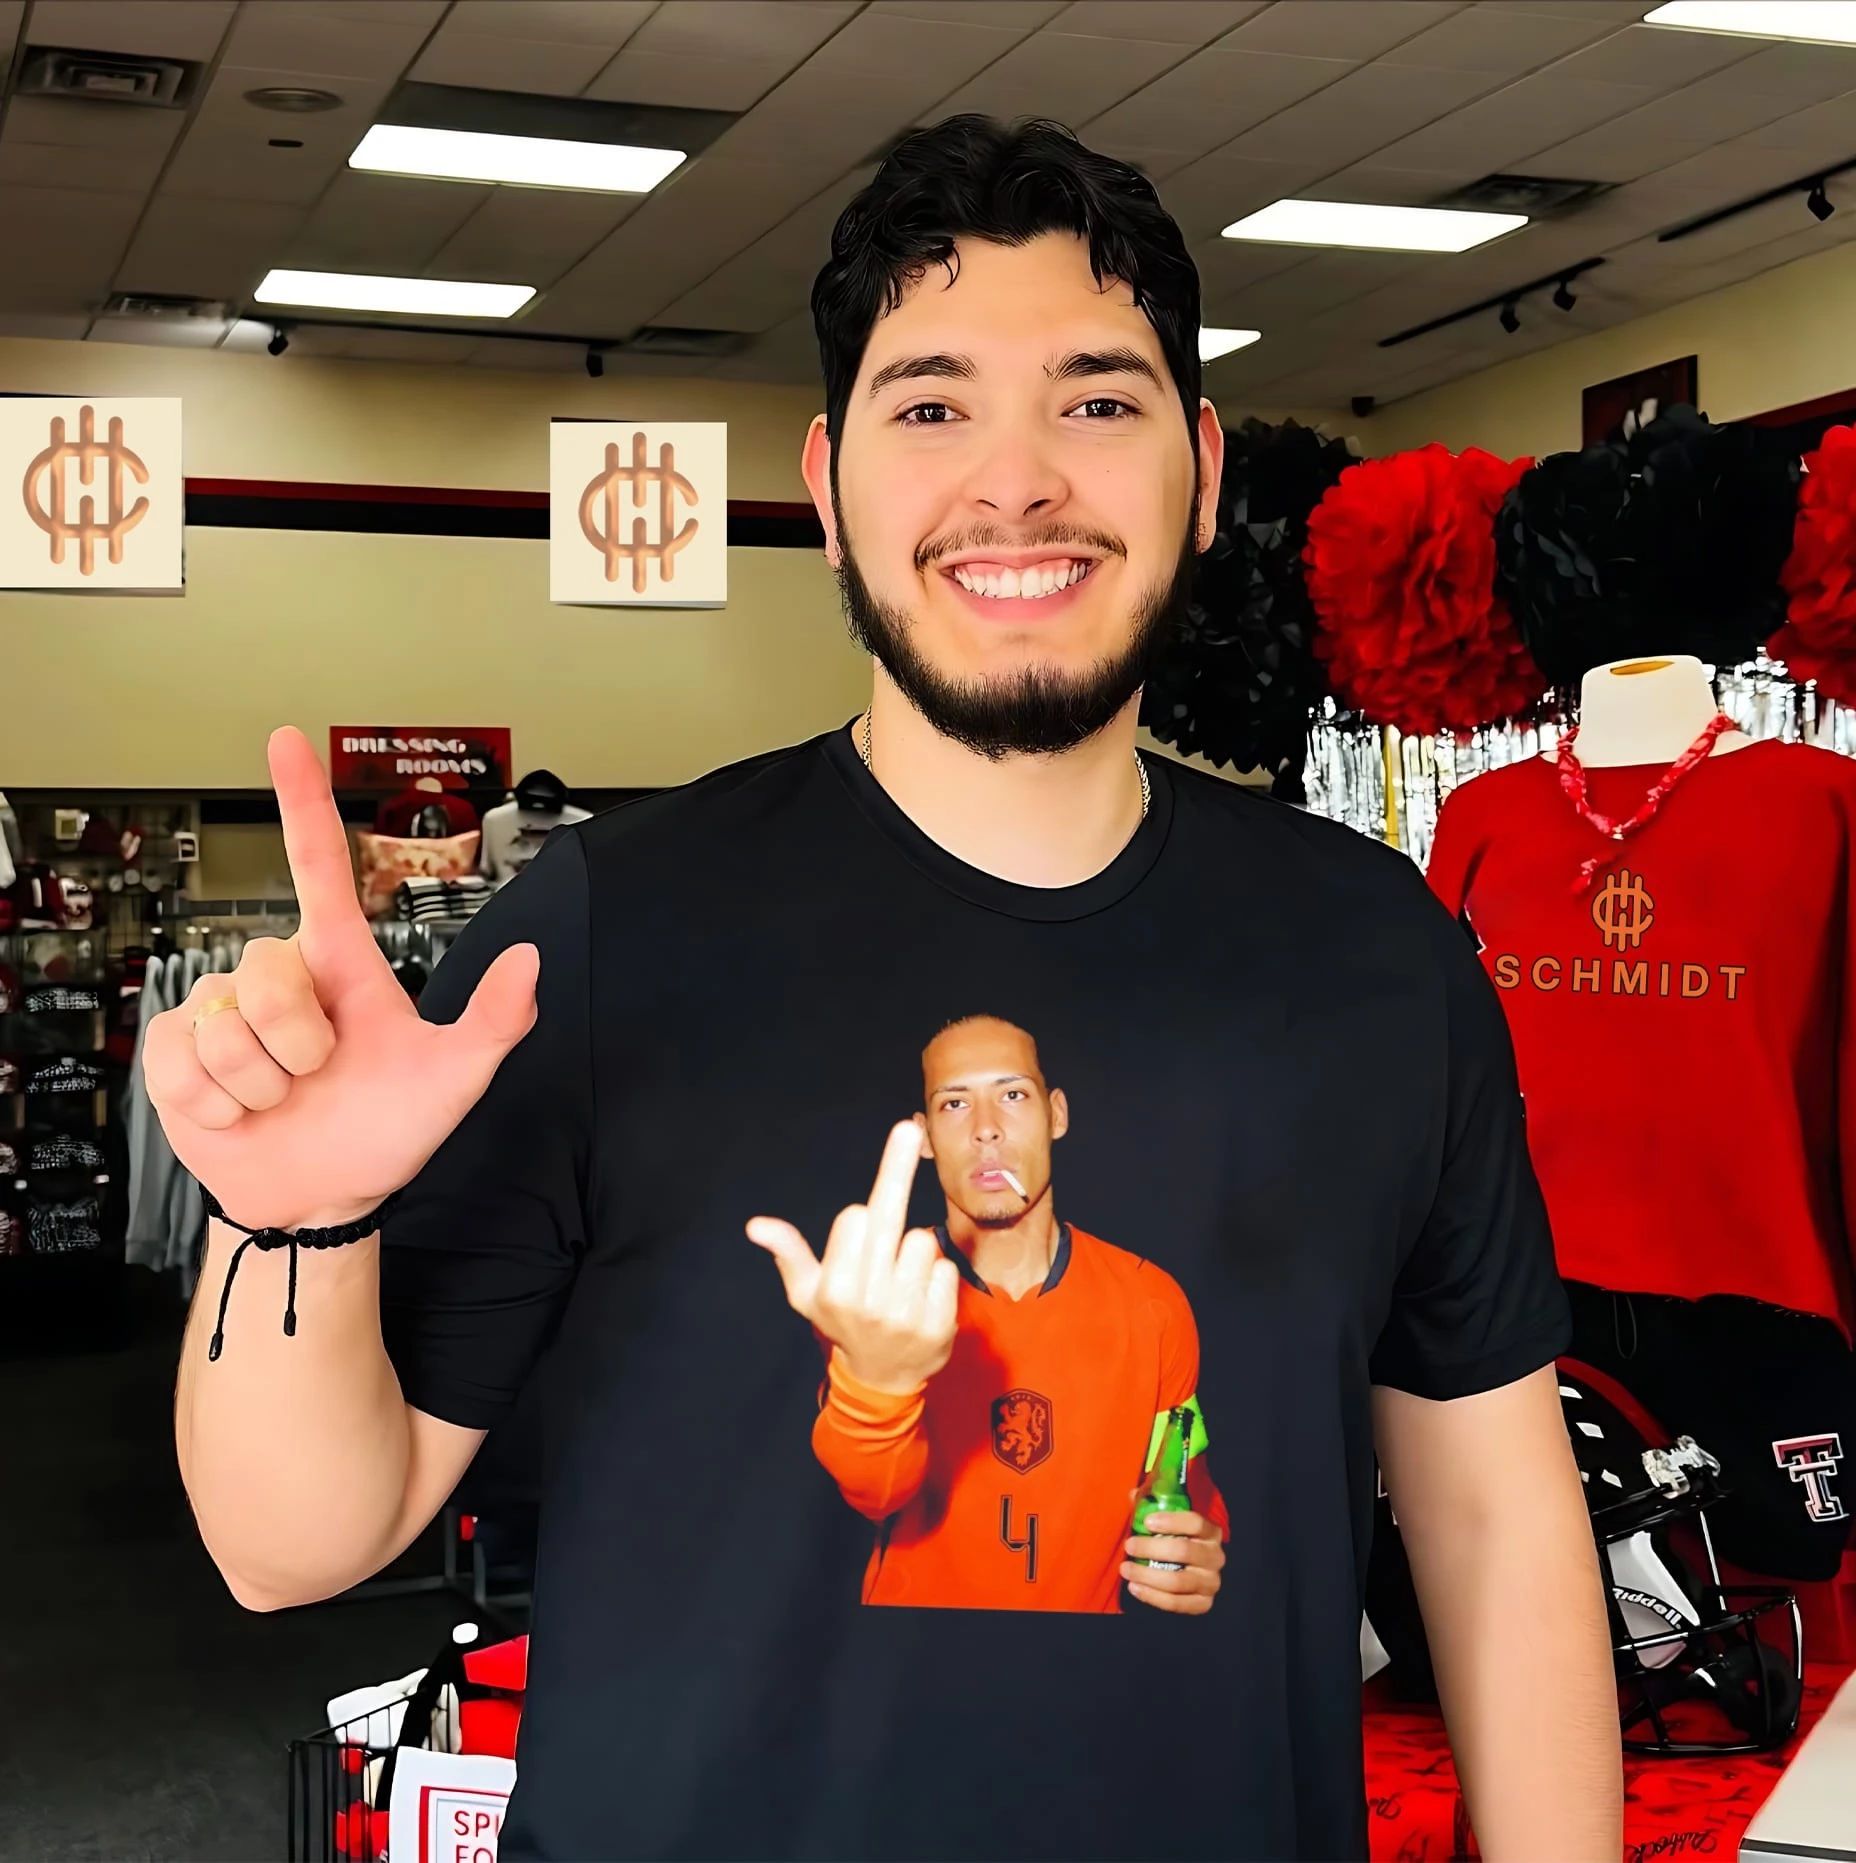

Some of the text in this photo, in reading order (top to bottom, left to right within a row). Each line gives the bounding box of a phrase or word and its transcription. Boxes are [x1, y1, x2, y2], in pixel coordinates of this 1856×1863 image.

[396, 758, 487, 775] ROOMS
[1494, 953, 1747, 1000] SCHMIDT
[1000, 1494, 1039, 1584] 4
